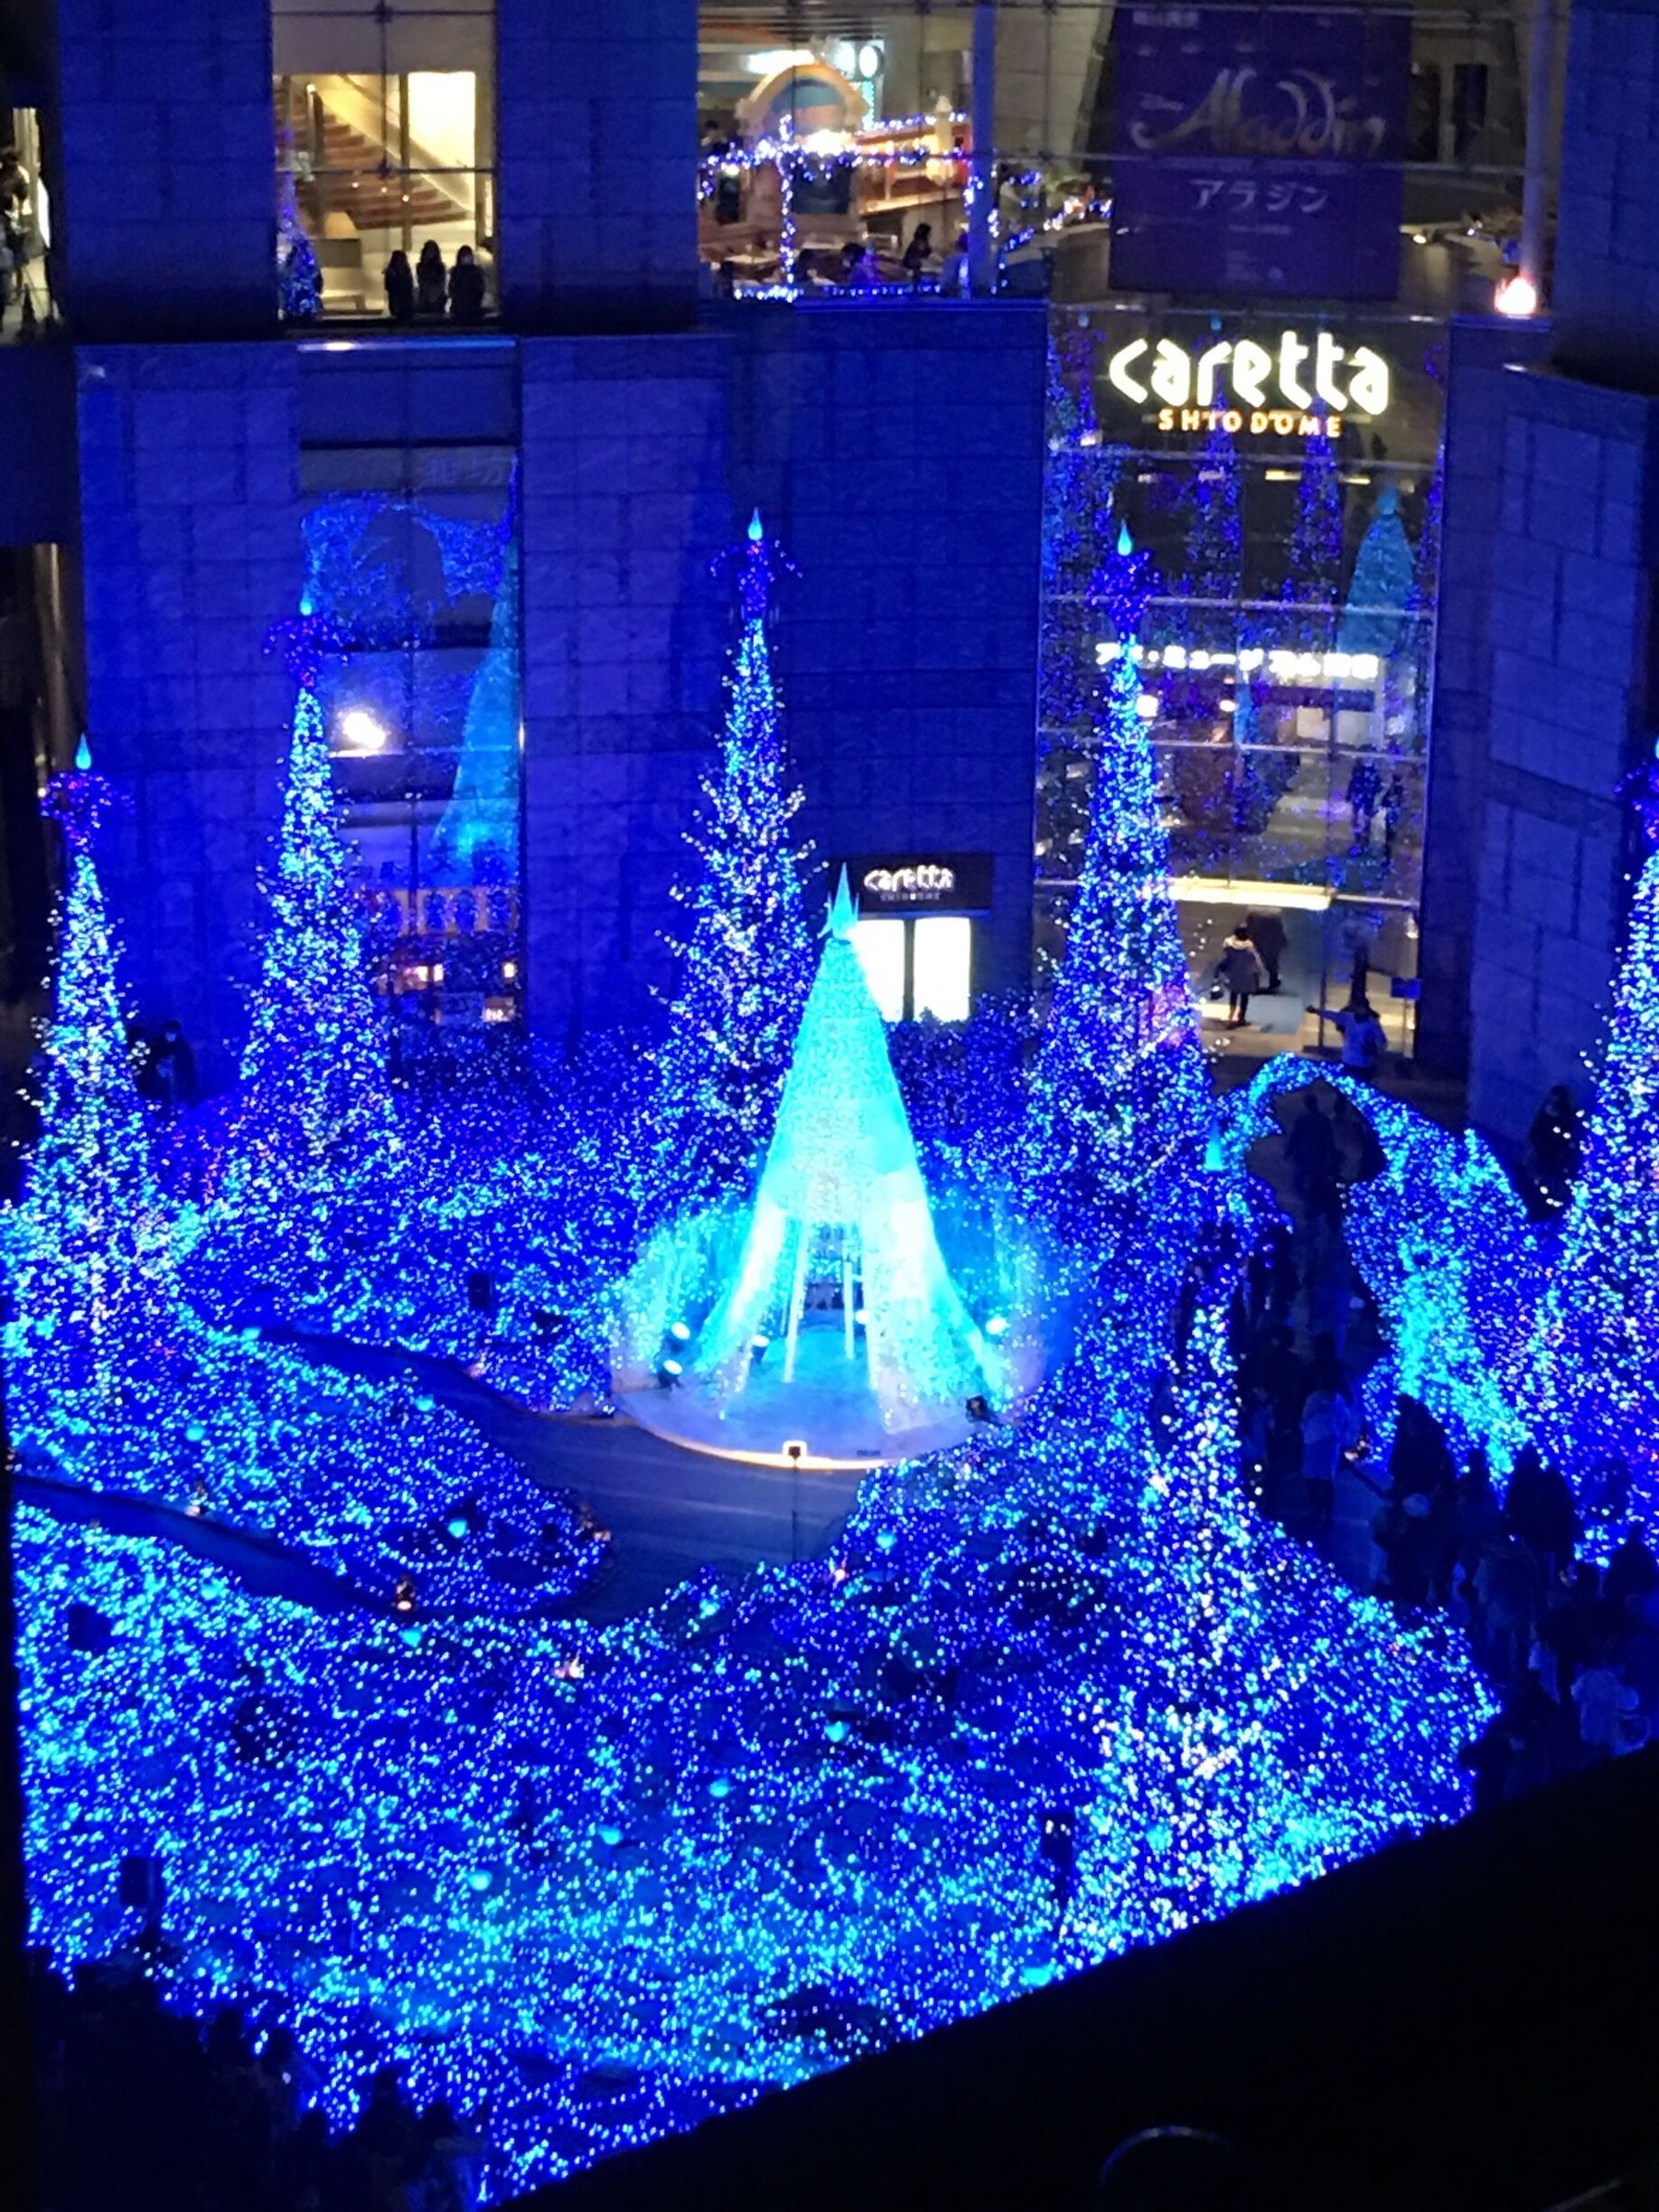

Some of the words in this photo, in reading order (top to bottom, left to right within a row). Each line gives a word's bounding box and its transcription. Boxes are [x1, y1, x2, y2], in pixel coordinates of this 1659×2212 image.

[1190, 179, 1329, 214] アラジン
[1109, 330, 1389, 415] caretta
[1158, 409, 1342, 438] SHIODOME
[864, 865, 954, 892] caretta
